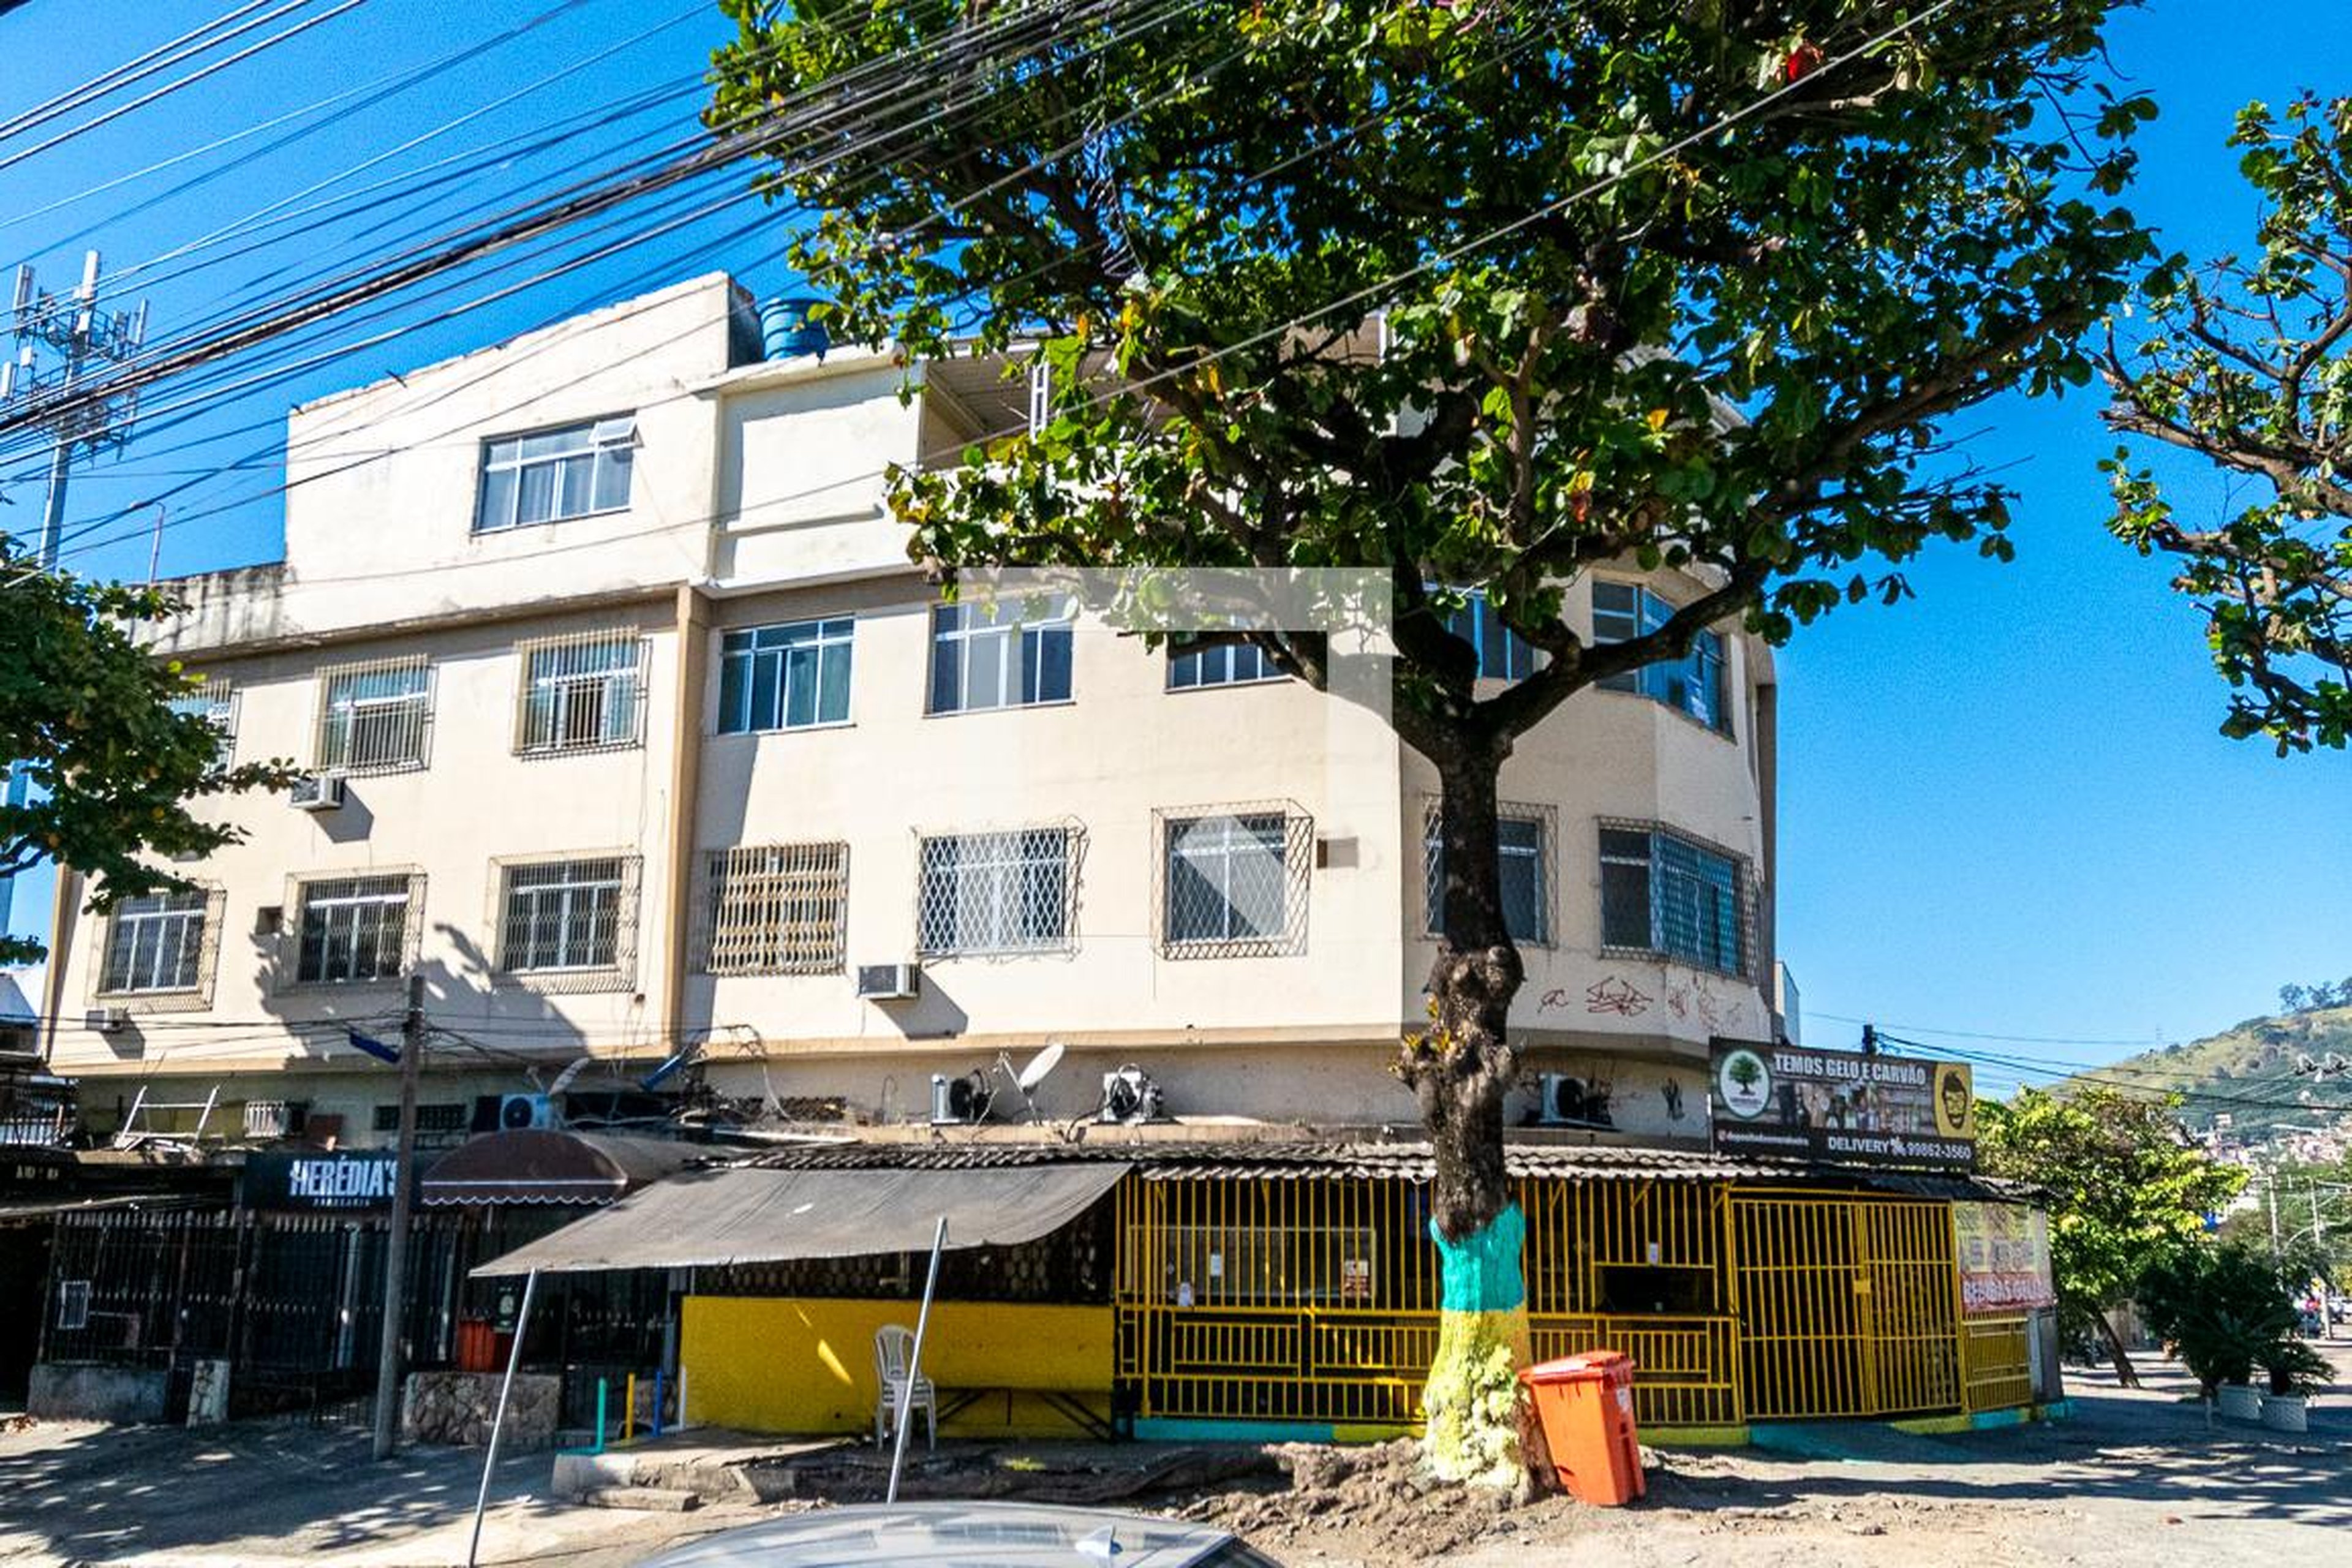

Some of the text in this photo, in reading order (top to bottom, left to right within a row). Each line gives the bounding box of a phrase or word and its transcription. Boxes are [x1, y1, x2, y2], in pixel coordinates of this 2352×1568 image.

[1774, 1053, 1926, 1085] TEMOS GELO E CARVÃO
[1828, 1137, 1889, 1153] DELIVERY
[290, 1155, 397, 1196] HERÉDIA'S
